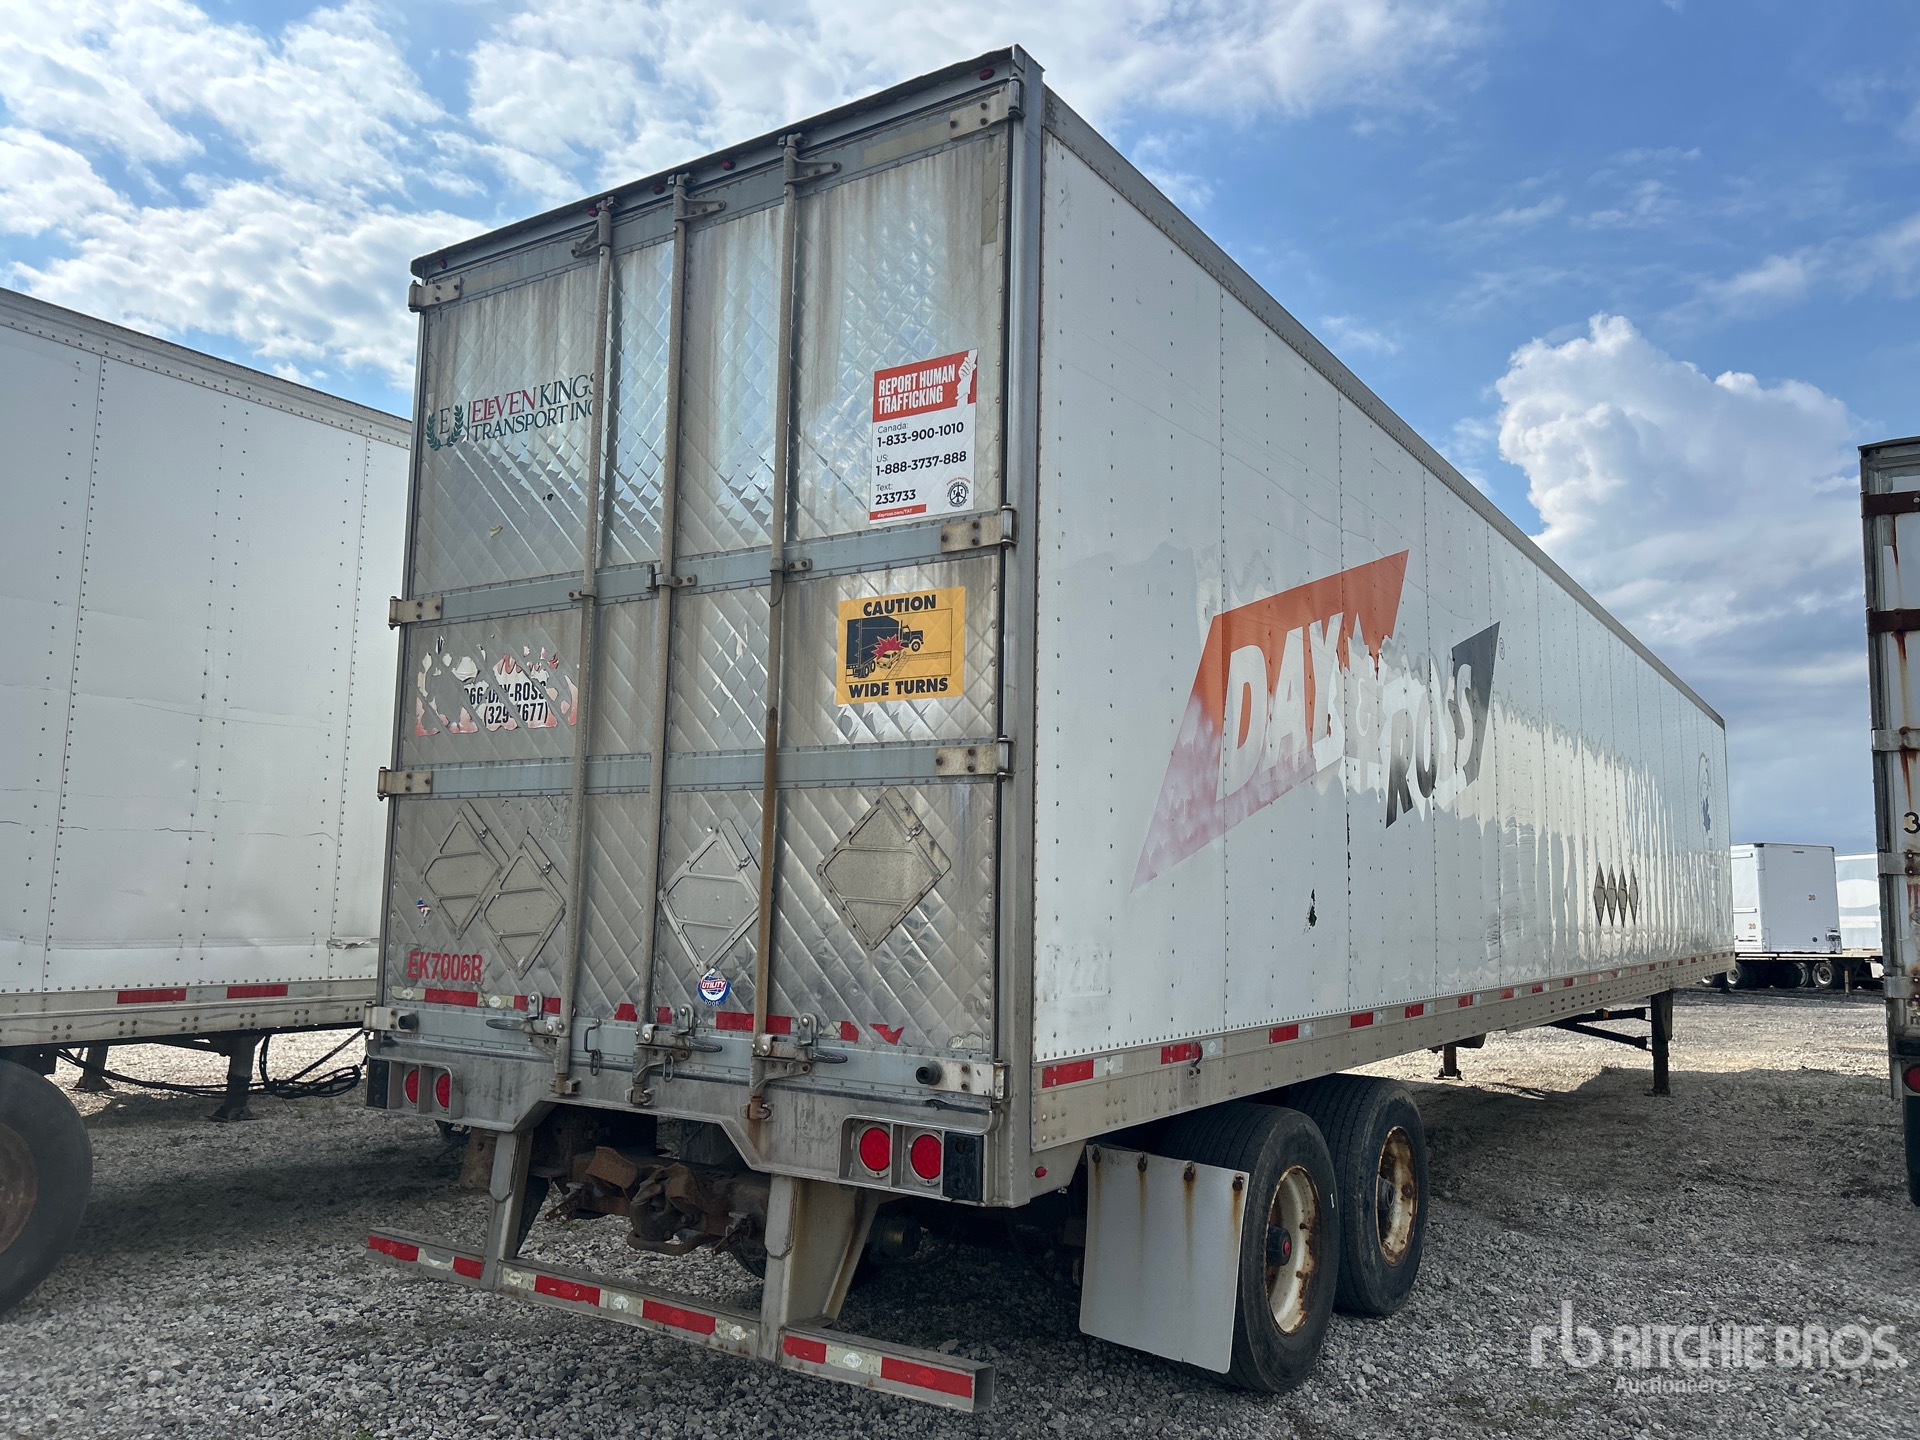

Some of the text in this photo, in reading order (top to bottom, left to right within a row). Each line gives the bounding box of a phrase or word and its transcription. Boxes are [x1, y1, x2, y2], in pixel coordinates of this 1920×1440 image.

[878, 364, 955, 397] REPORT HUMAN
[471, 386, 537, 423] ELEVEN
[878, 385, 943, 415] TRAFFICKING
[471, 404, 568, 442] TRANSPORT
[877, 422, 909, 434] Canada:
[877, 422, 964, 448] 1-833-900-1010
[876, 455, 888, 463] US:
[876, 451, 967, 476] 1-888-3737-888
[875, 489, 917, 505] 233733
[876, 483, 893, 492] Text:
[863, 594, 937, 617] CAUTION
[848, 677, 949, 699] WIDE TURNS
[1216, 612, 1344, 802] DAY
[701, 980, 726, 990] UTILITY
